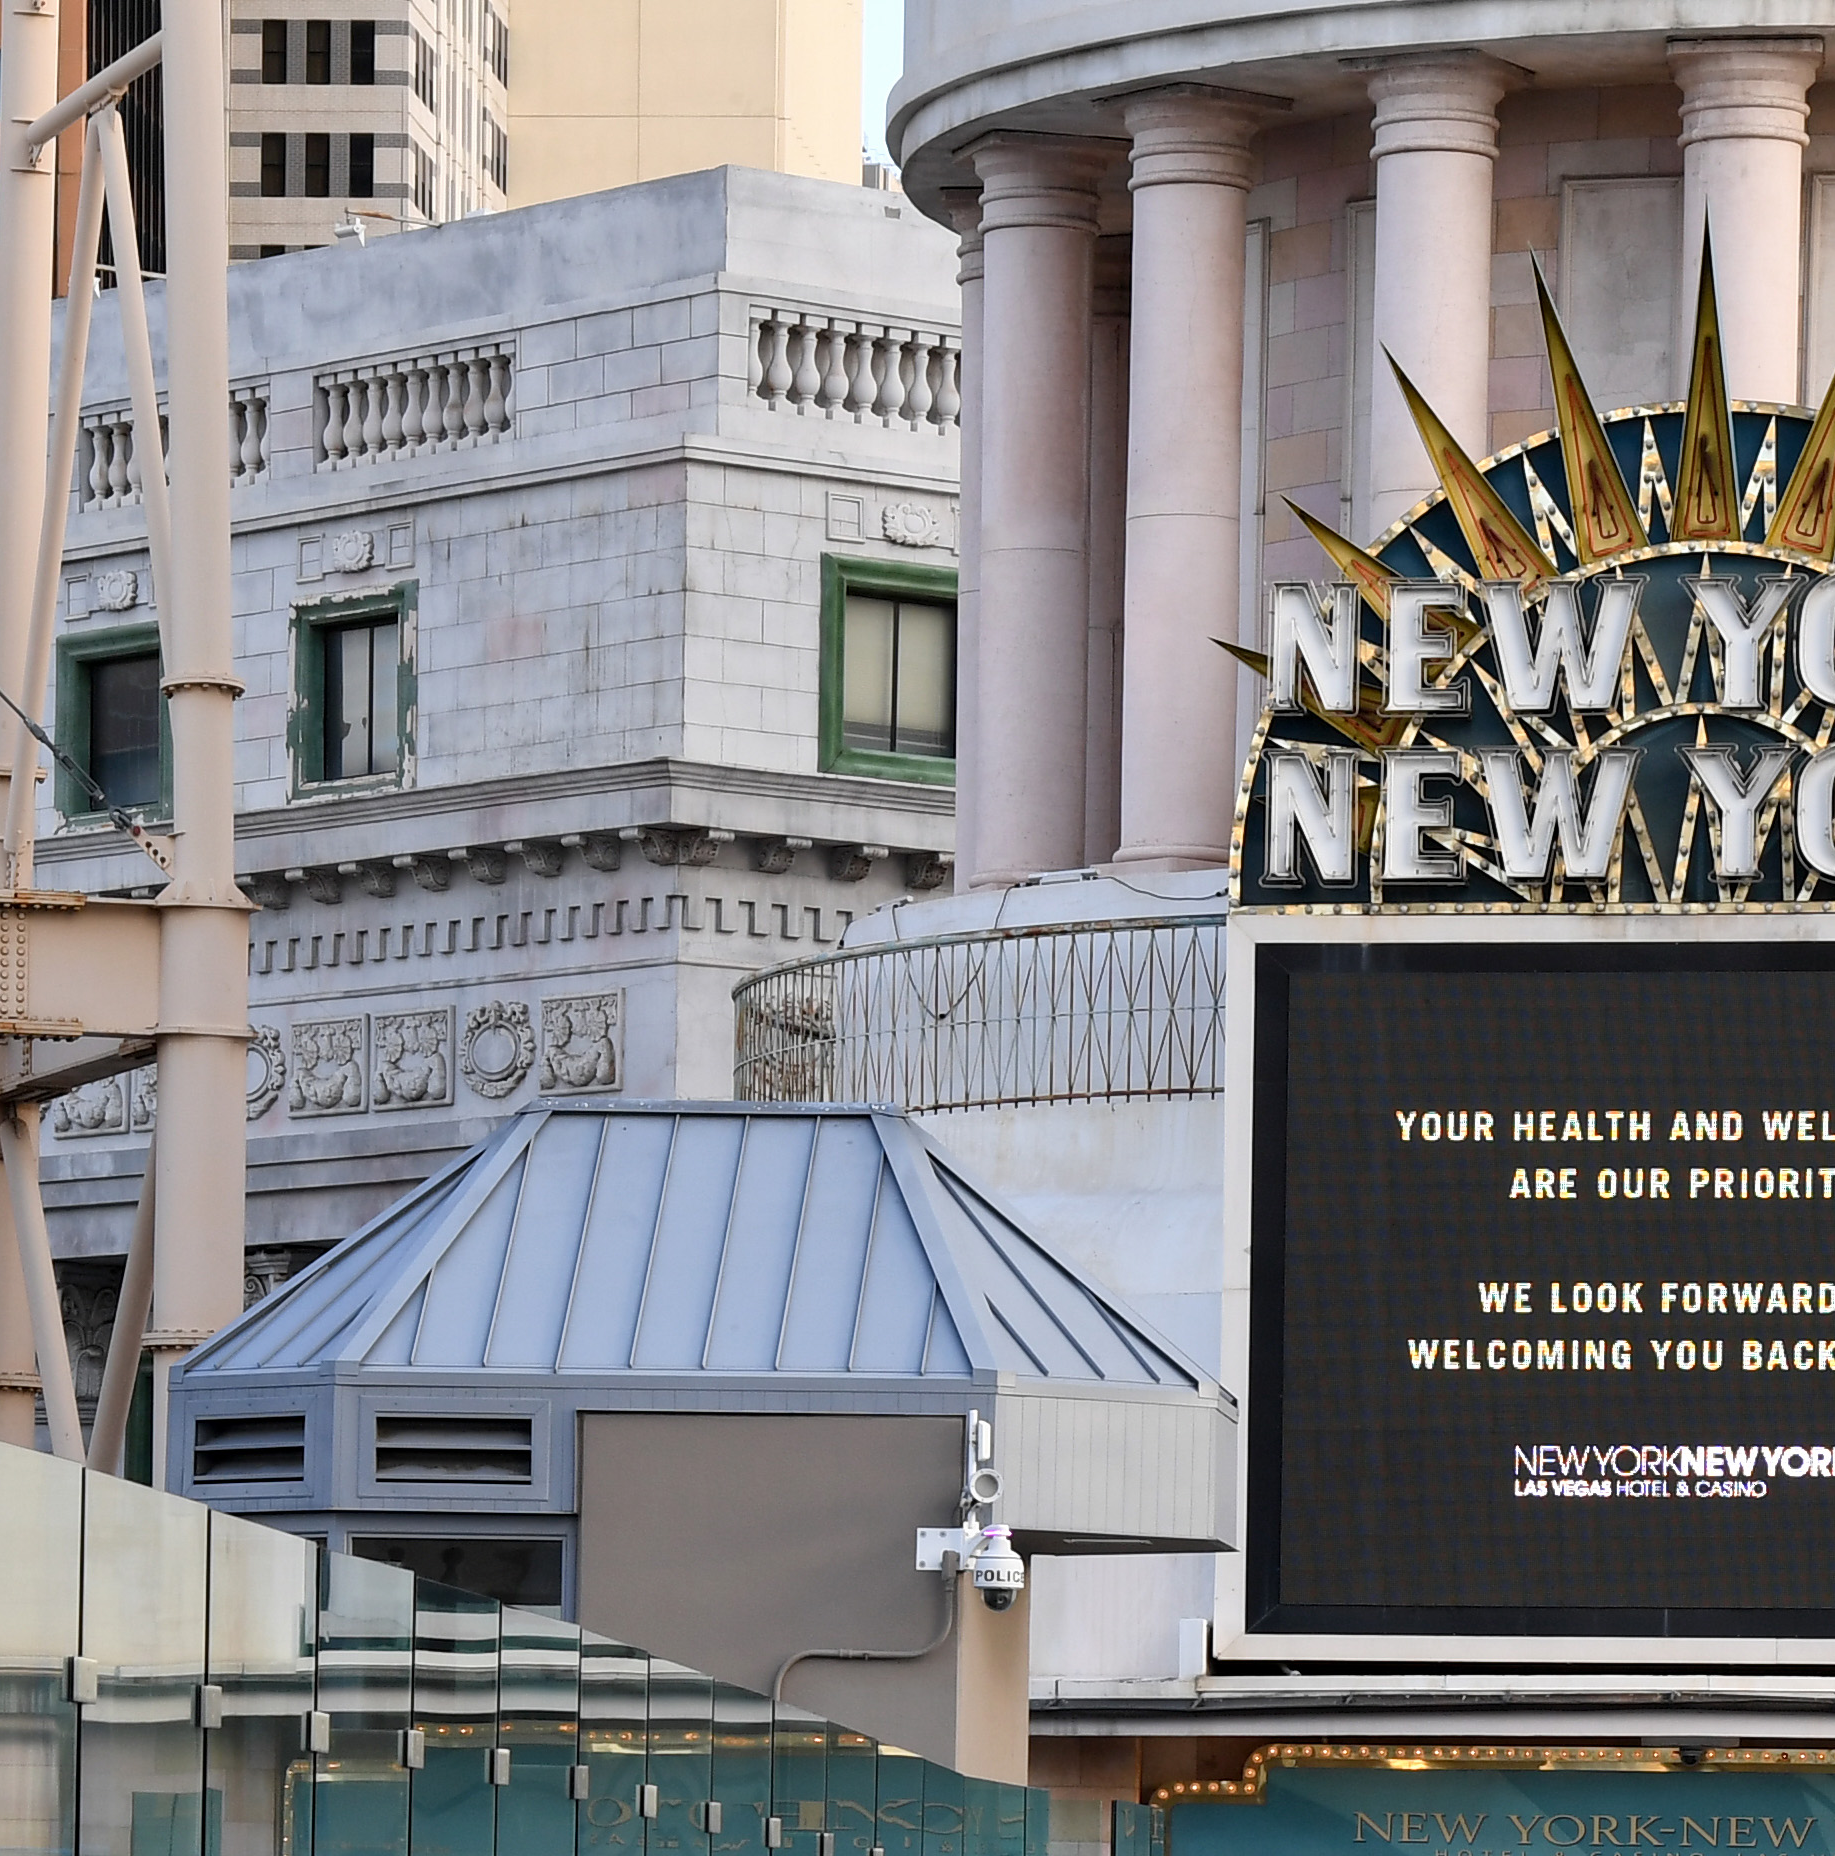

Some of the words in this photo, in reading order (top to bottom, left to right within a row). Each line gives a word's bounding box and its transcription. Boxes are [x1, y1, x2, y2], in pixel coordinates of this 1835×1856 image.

[1267, 571, 1650, 718] NEW
[1260, 743, 1647, 889] NEW
[1395, 1110, 1495, 1142] YOUR
[1513, 1110, 1652, 1142] HEALTH
[1668, 1110, 1744, 1142] AND
[1509, 1167, 1578, 1200] ARE
[1597, 1167, 1670, 1200] OUR
[1477, 1281, 1533, 1314] WE
[1550, 1281, 1644, 1314] LOOK
[1407, 1339, 1633, 1371] WELCOMING
[1649, 1339, 1725, 1372] YOU
[1514, 1480, 1548, 1498] LAS
[1552, 1480, 1612, 1498] VEGAS
[1616, 1480, 1672, 1498] HOTEL
[1694, 1480, 1768, 1499] CASINO
[1353, 1811, 1489, 1844] NEW
[1506, 1813, 1819, 1848] YORK-NEW
